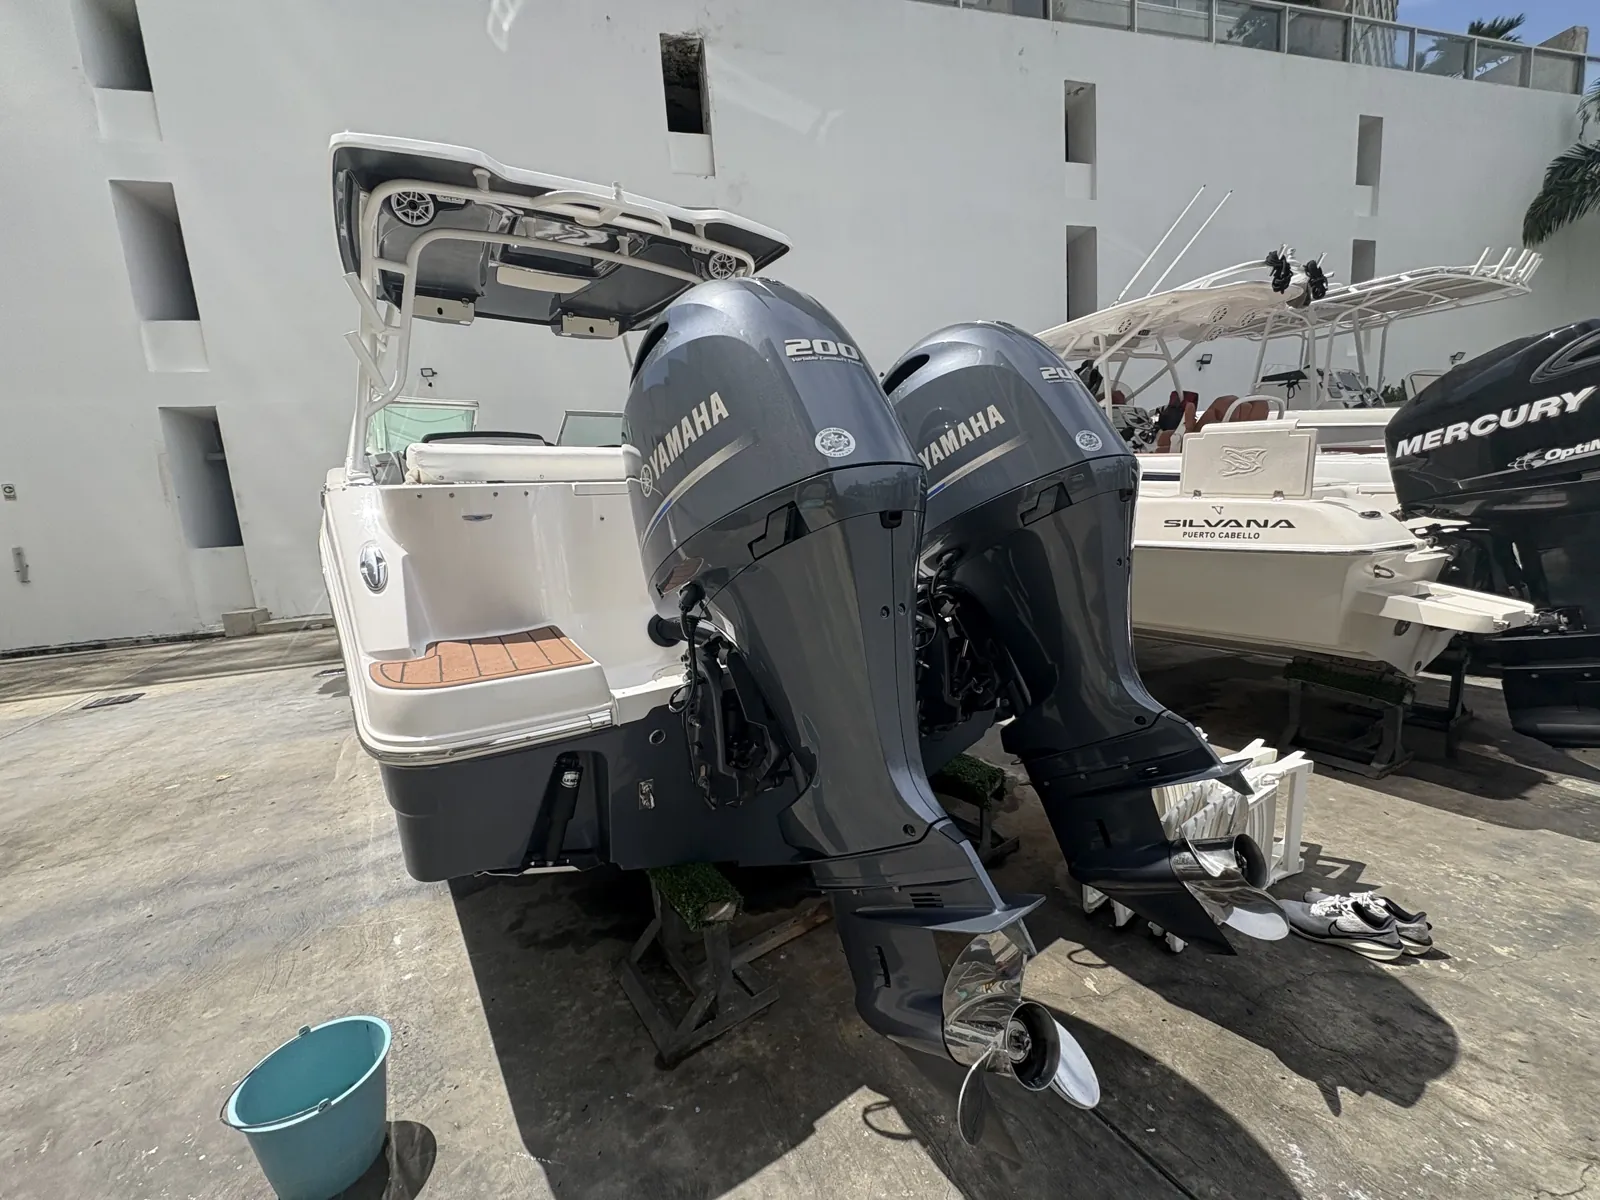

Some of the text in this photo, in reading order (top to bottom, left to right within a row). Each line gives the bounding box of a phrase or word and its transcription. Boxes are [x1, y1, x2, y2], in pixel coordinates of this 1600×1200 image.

[783, 338, 860, 360] 200
[649, 391, 729, 480] YAMAHA
[917, 404, 1006, 471] YAMAHA
[1395, 385, 1598, 458] MERCURY
[1163, 519, 1296, 529] SILVANA
[1182, 531, 1260, 540] PUERTO CABELLO
